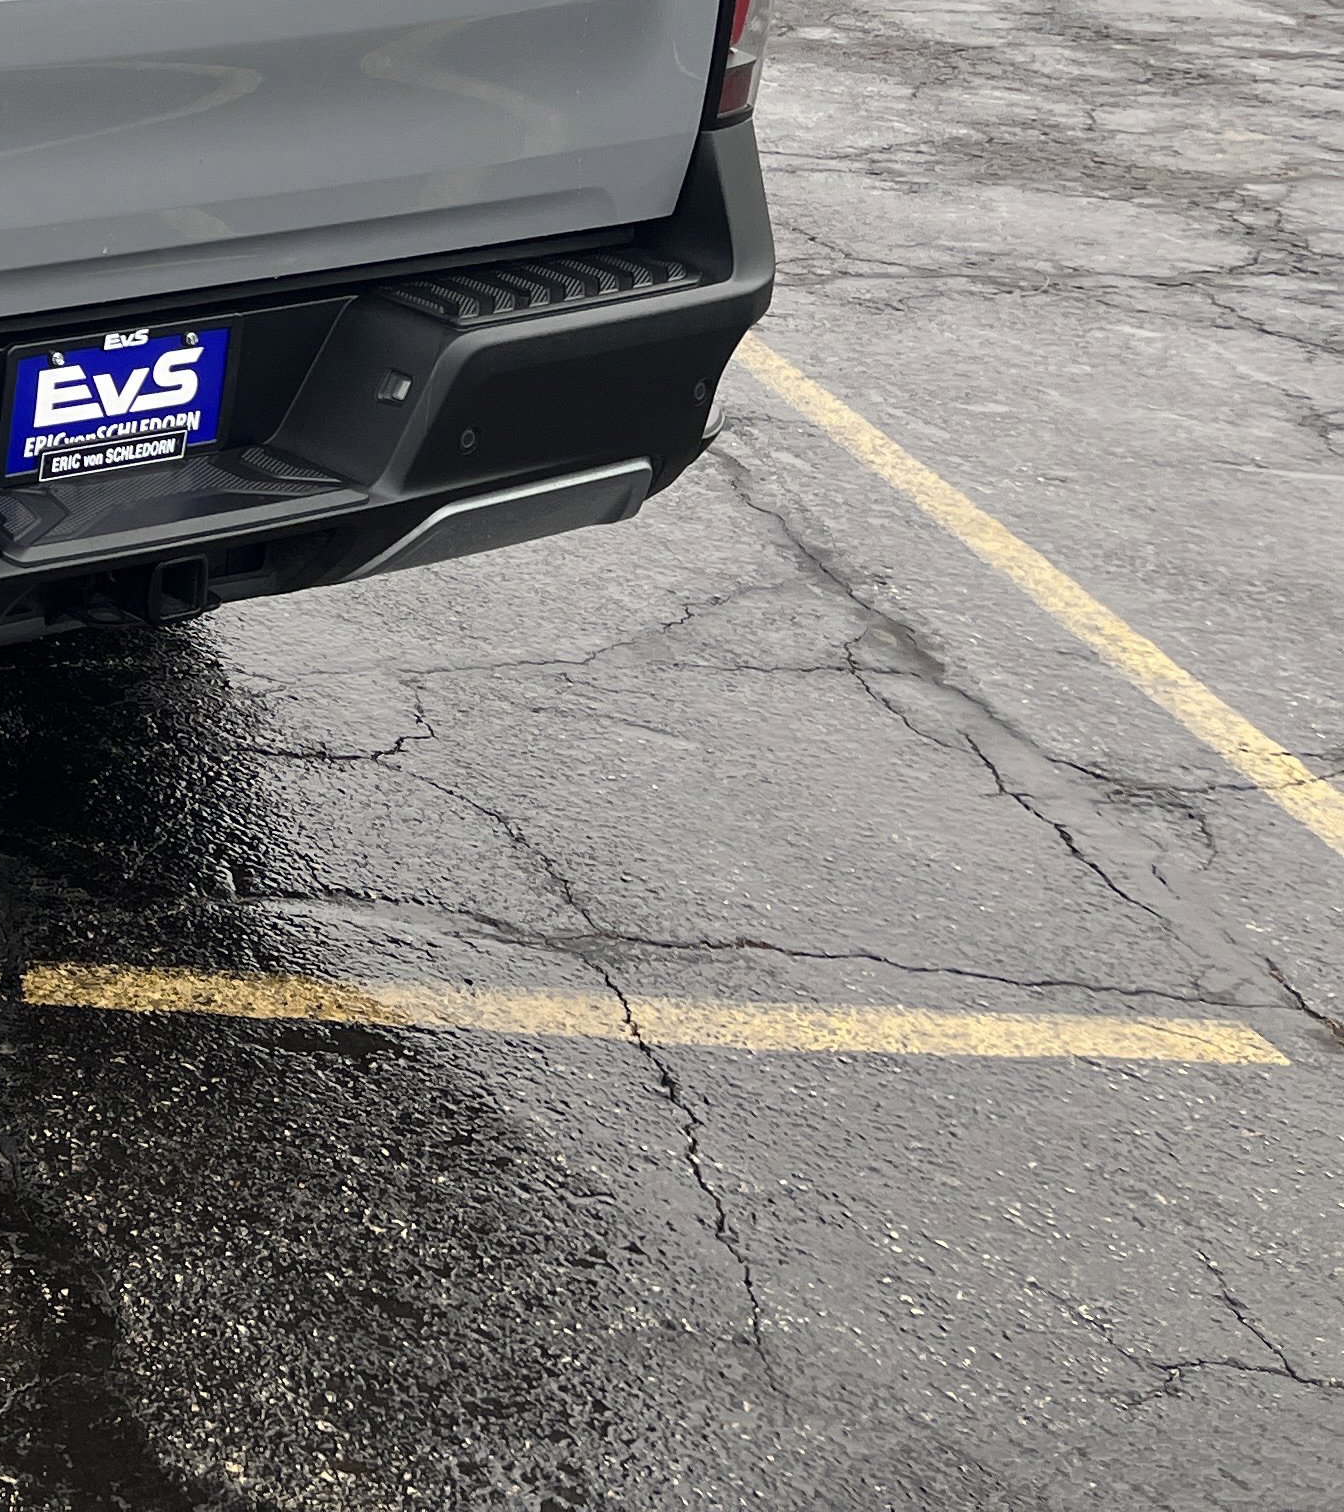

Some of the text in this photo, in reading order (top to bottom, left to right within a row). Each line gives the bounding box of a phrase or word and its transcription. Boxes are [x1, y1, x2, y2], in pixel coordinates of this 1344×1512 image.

[51, 437, 177, 473] ERIC von SCHLEDORN
